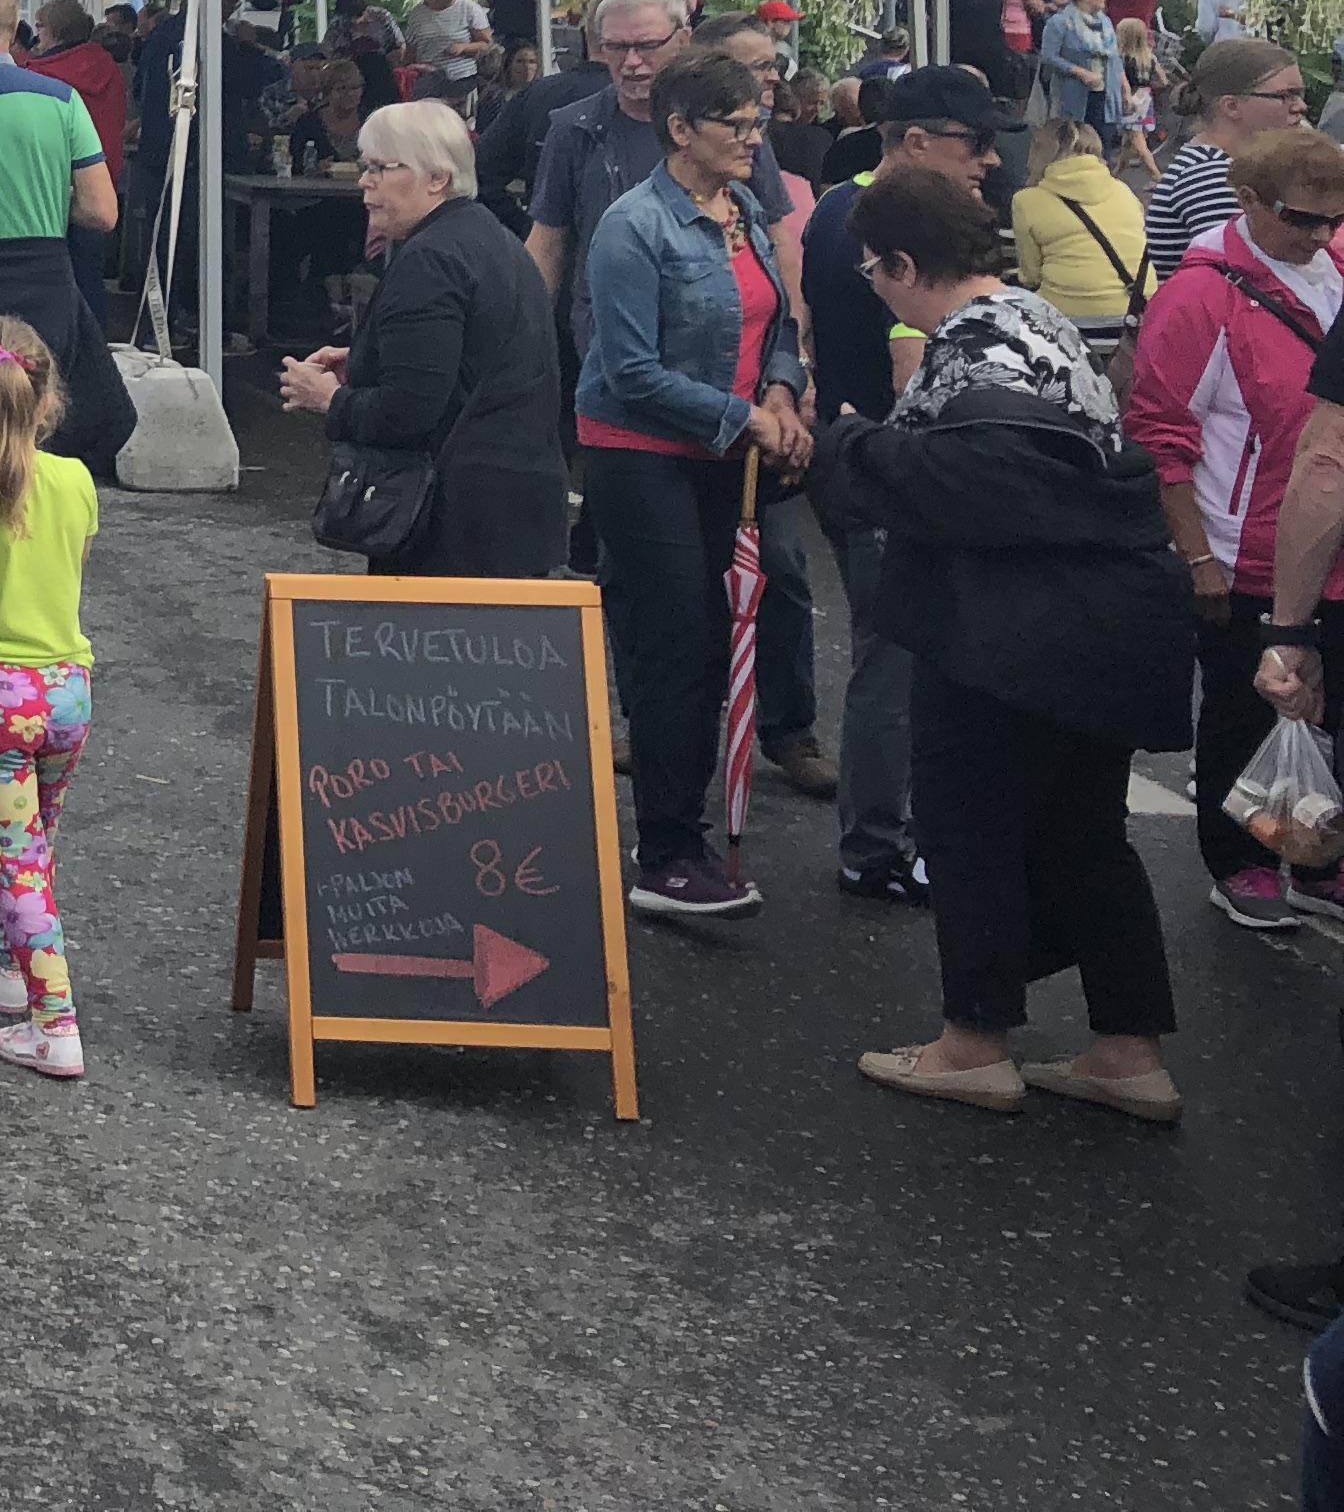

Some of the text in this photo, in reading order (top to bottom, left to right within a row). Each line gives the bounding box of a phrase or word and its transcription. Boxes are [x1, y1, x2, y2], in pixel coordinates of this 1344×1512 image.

[310, 620, 567, 671] TERVETULOA
[314, 678, 575, 742] TALONPÖYTÄÄN
[308, 751, 465, 807] PORO TAI
[327, 760, 572, 855] KASVISBURGERI
